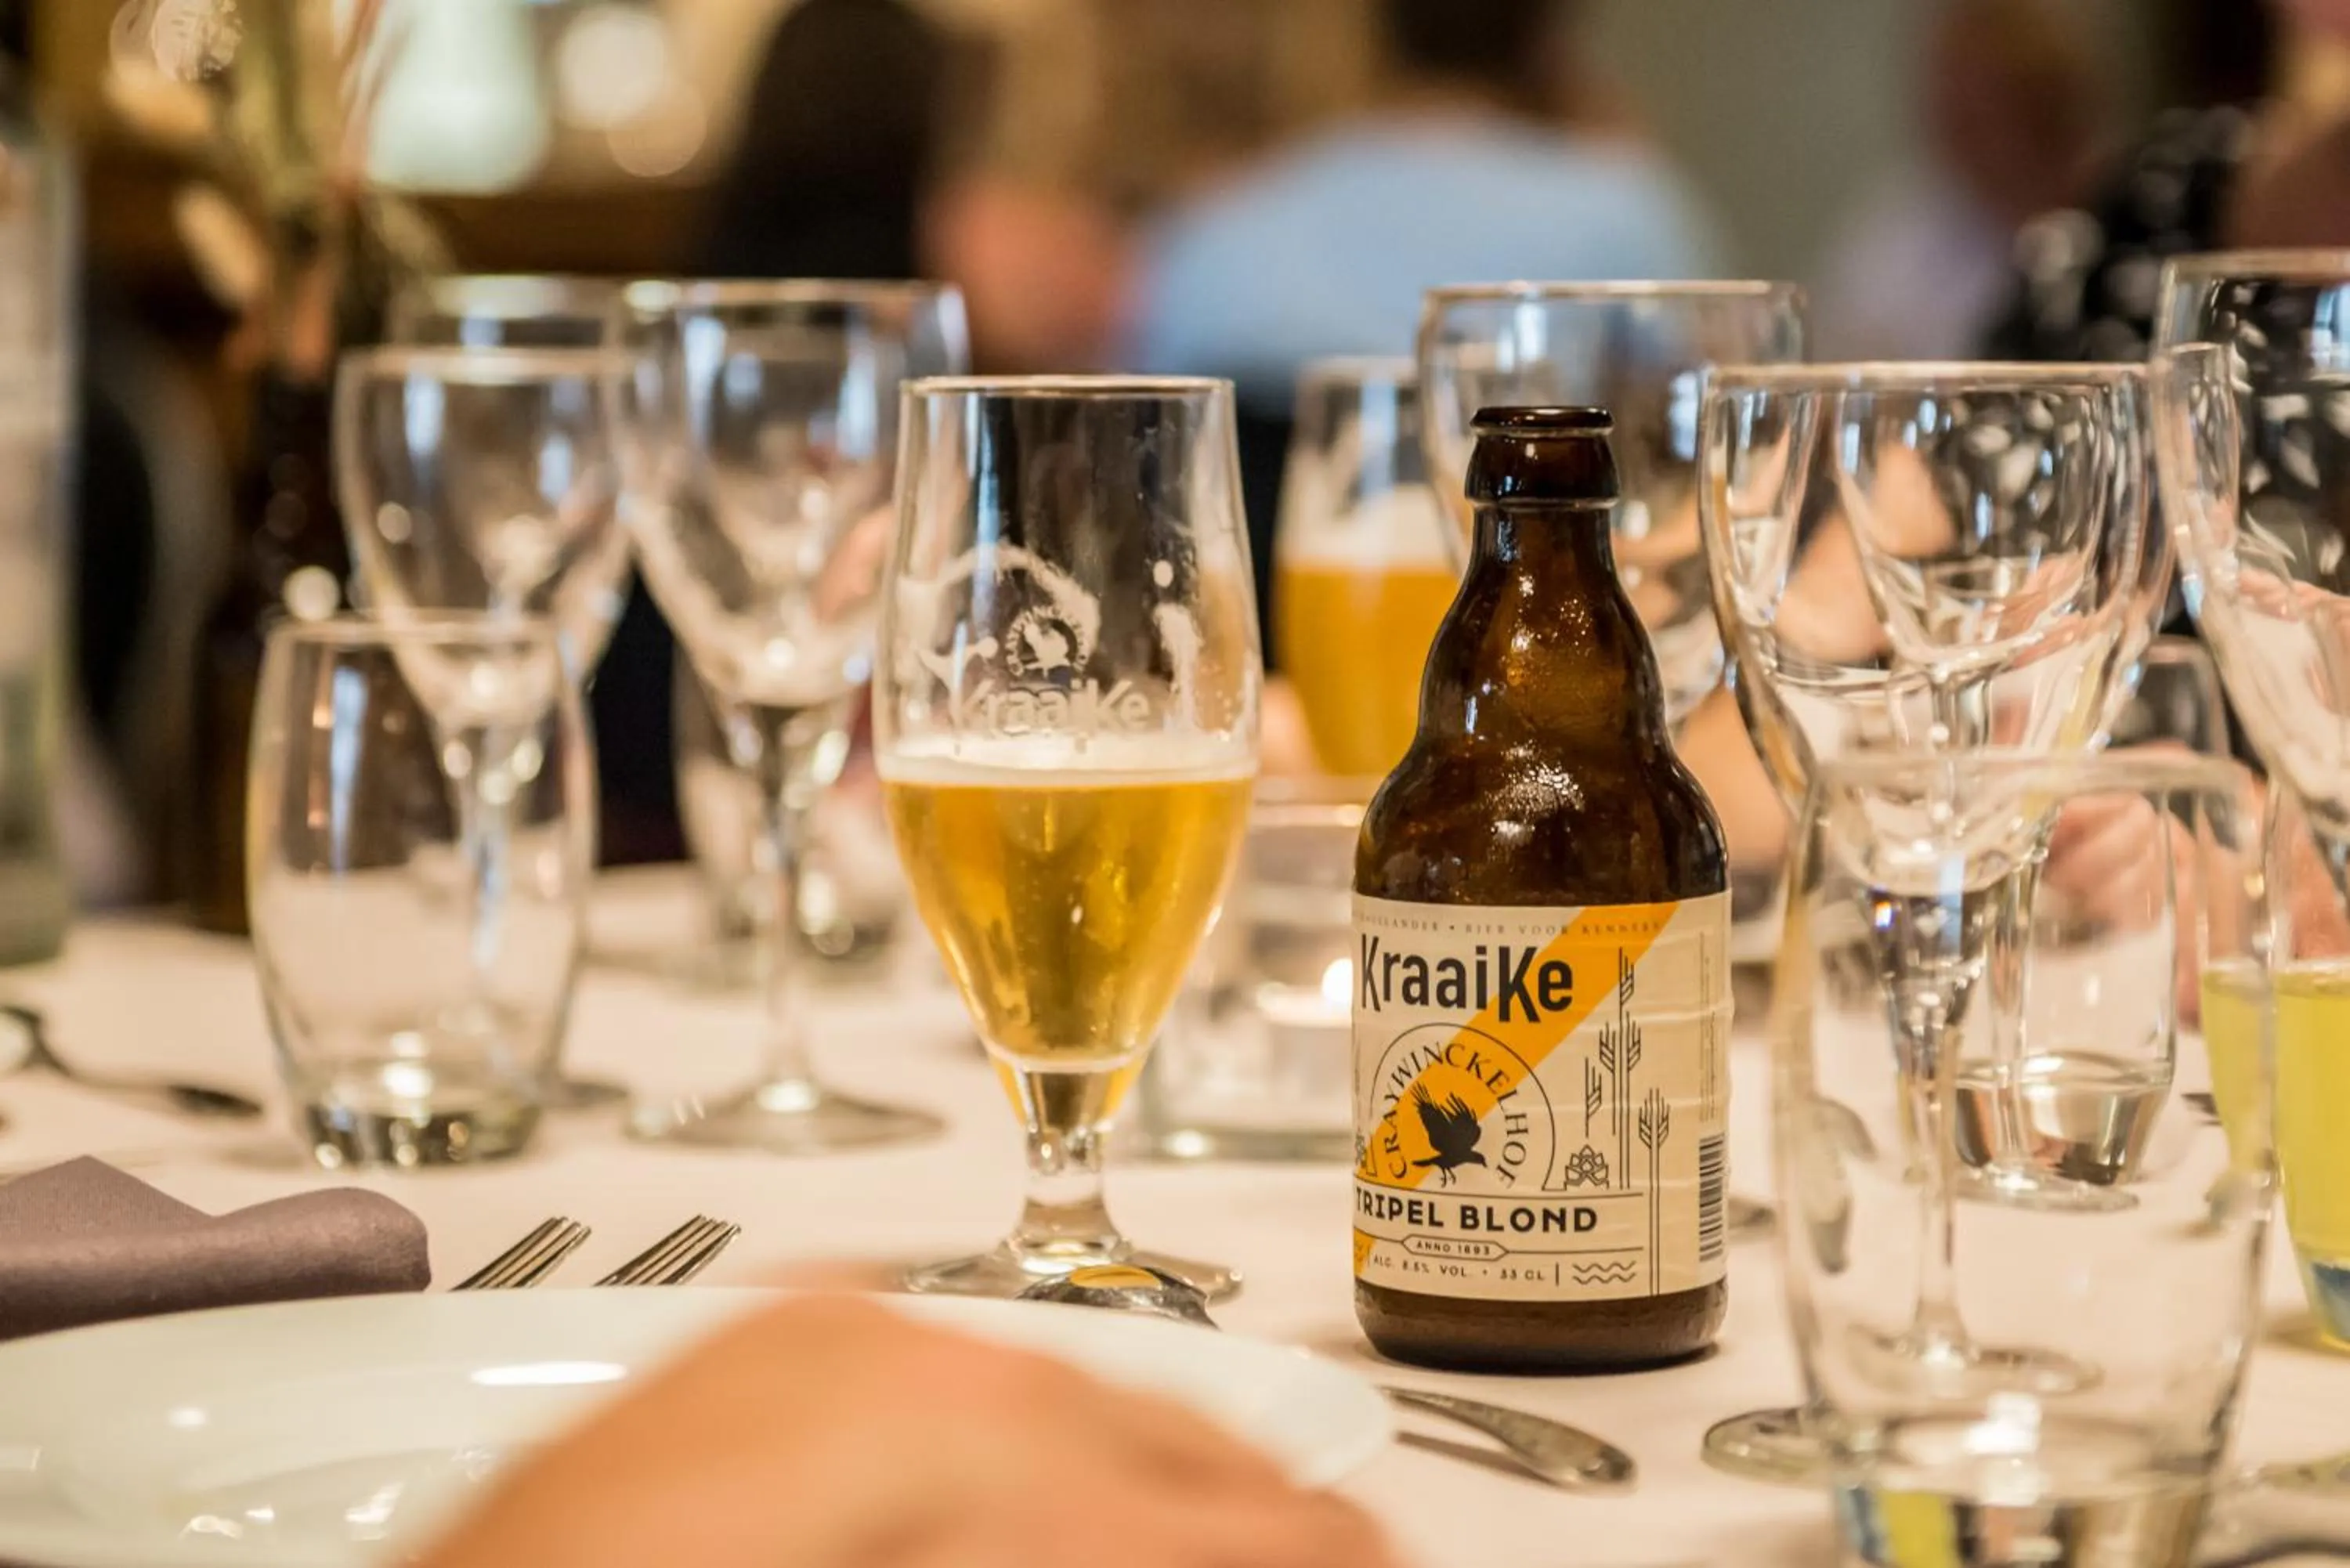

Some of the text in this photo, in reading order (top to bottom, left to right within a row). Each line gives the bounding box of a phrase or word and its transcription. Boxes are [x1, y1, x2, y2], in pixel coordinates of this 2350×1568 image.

[1465, 923, 1506, 934] BIER
[1518, 923, 1568, 936] VOOR
[1361, 934, 1574, 1024] KraaiKe
[1383, 1041, 1530, 1189] CRAYWINCKELHOF
[1356, 1186, 1597, 1233] TRIPEL BLOND
[1416, 1240, 1452, 1253] ANNO
[1499, 1267, 1518, 1281] 33
[1524, 1269, 1546, 1281] CL
